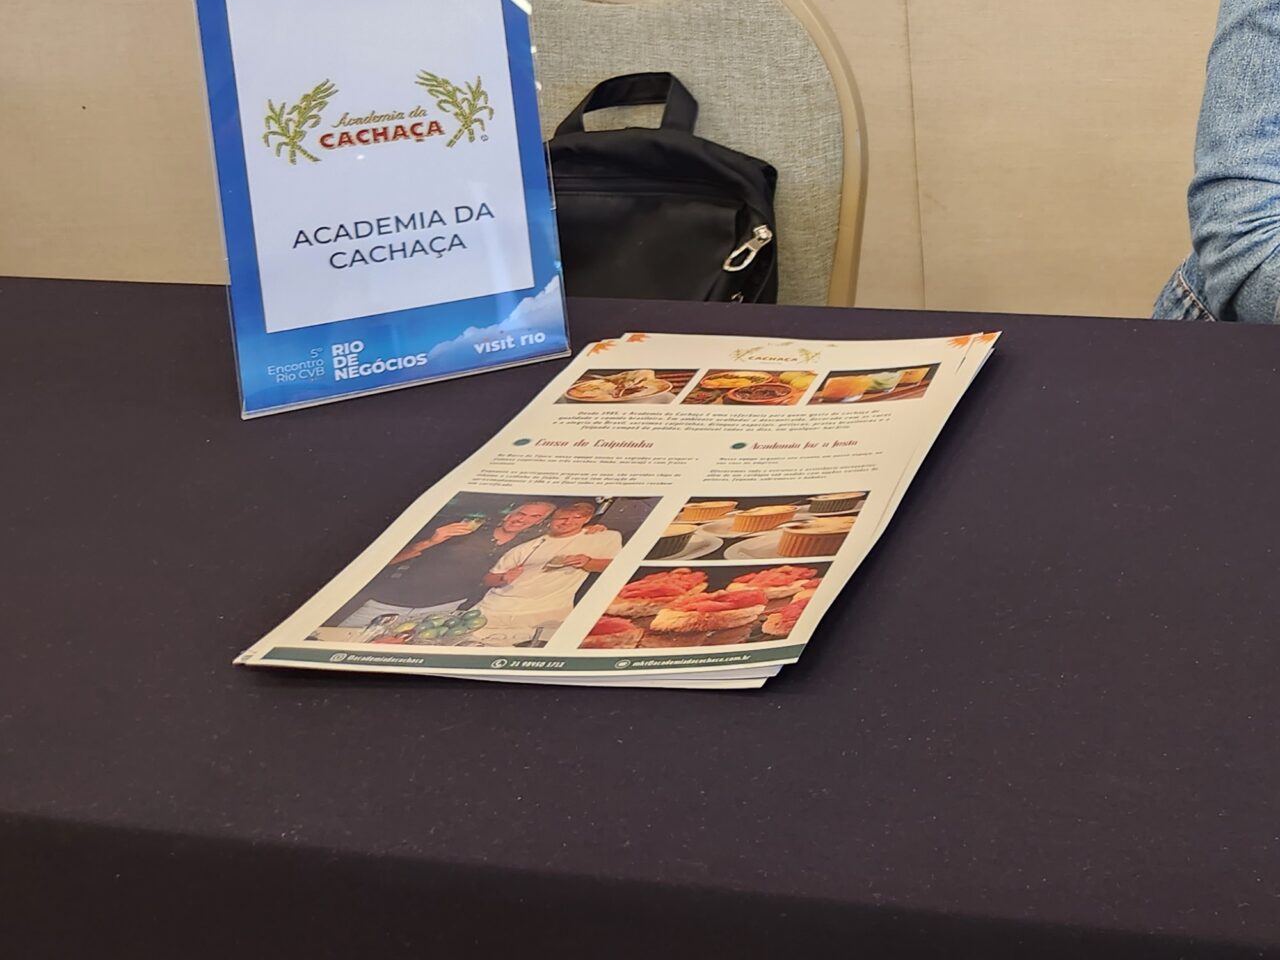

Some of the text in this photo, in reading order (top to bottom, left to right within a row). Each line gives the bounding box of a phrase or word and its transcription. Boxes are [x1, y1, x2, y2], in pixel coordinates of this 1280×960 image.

[332, 105, 428, 128] Academia da
[319, 120, 445, 149] CACHAÇA
[292, 201, 495, 249] ACADEMIA DA
[329, 233, 467, 269] CACHAÇA
[331, 340, 364, 356] RIO
[473, 330, 546, 355] visit rio
[267, 359, 325, 376] Encontro
[333, 353, 359, 369] DE
[334, 352, 428, 381] NEGÓCIOS
[276, 366, 325, 383] Rio CVB
[573, 438, 590, 447] de
